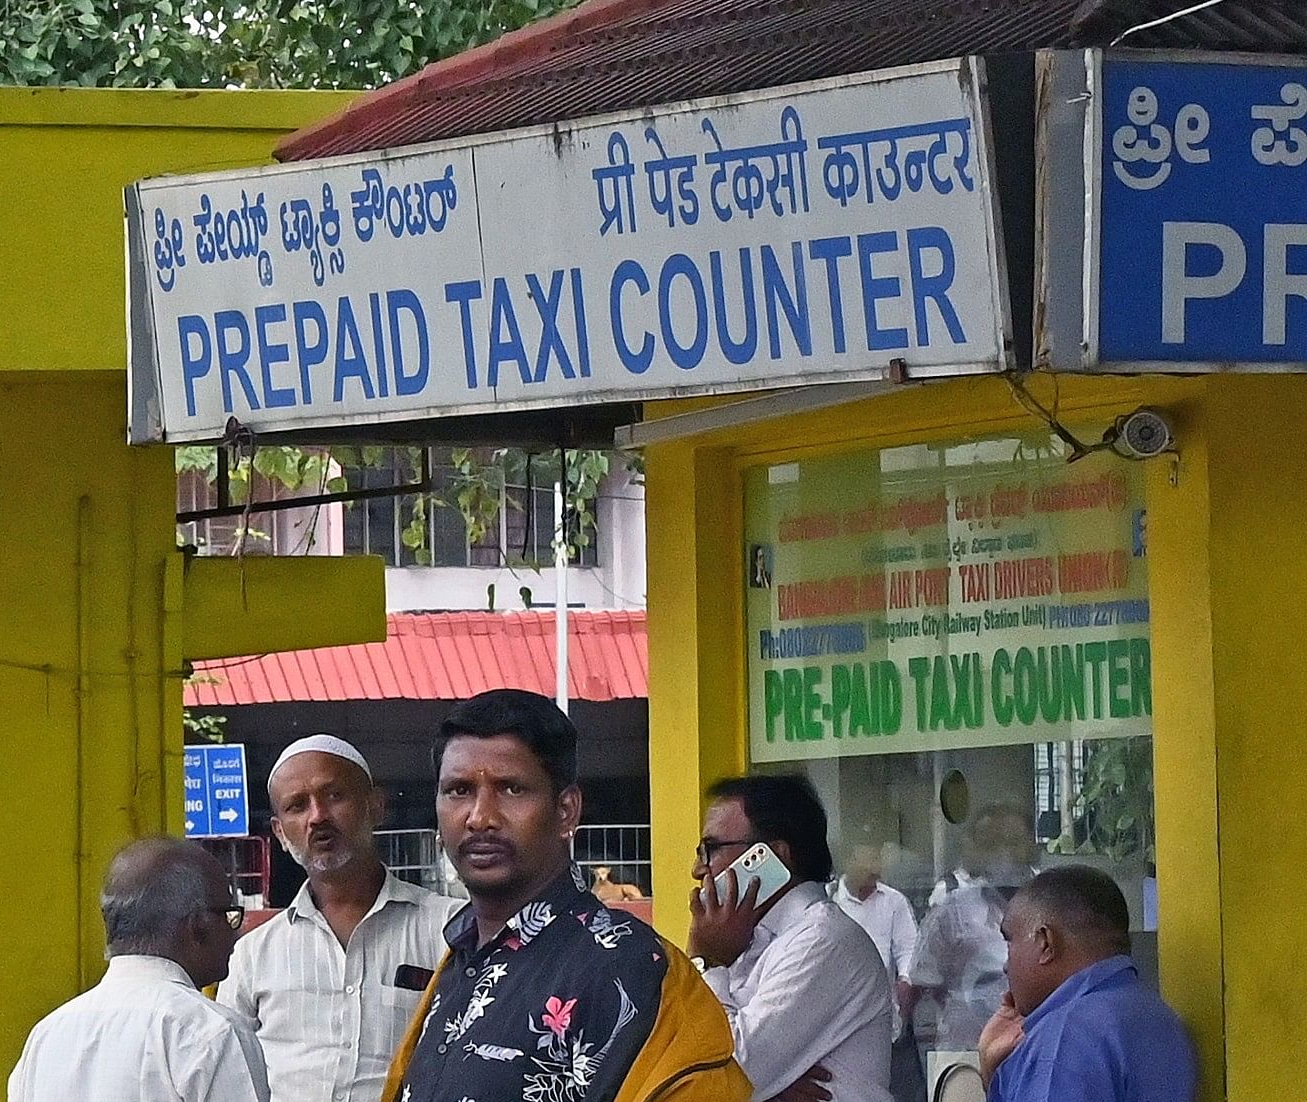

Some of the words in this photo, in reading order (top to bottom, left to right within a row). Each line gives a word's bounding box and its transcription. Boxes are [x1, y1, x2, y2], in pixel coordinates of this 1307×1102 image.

[153, 207, 185, 292] ಪ್ರೀ
[193, 189, 274, 287] ಪೇಯ್ಡ್
[280, 182, 346, 287] ಟ್ಯಾಕ್ಸಿ
[350, 164, 458, 243] ಕೌಂಟರ್
[591, 130, 637, 236] प्री
[643, 123, 699, 228] पेड
[819, 117, 975, 208] काउन्टर
[178, 287, 430, 417] PREPAID
[445, 267, 592, 390] TAXI
[609, 226, 968, 374] COUNTER
[920, 611, 941, 641] City
[983, 606, 1019, 633] Station
[958, 562, 991, 604] TAXI
[764, 658, 903, 745] PRE-PAID
[909, 652, 983, 734] TAXI
[991, 637, 1152, 729] COUNTER
[215, 789, 241, 800] EXIT
